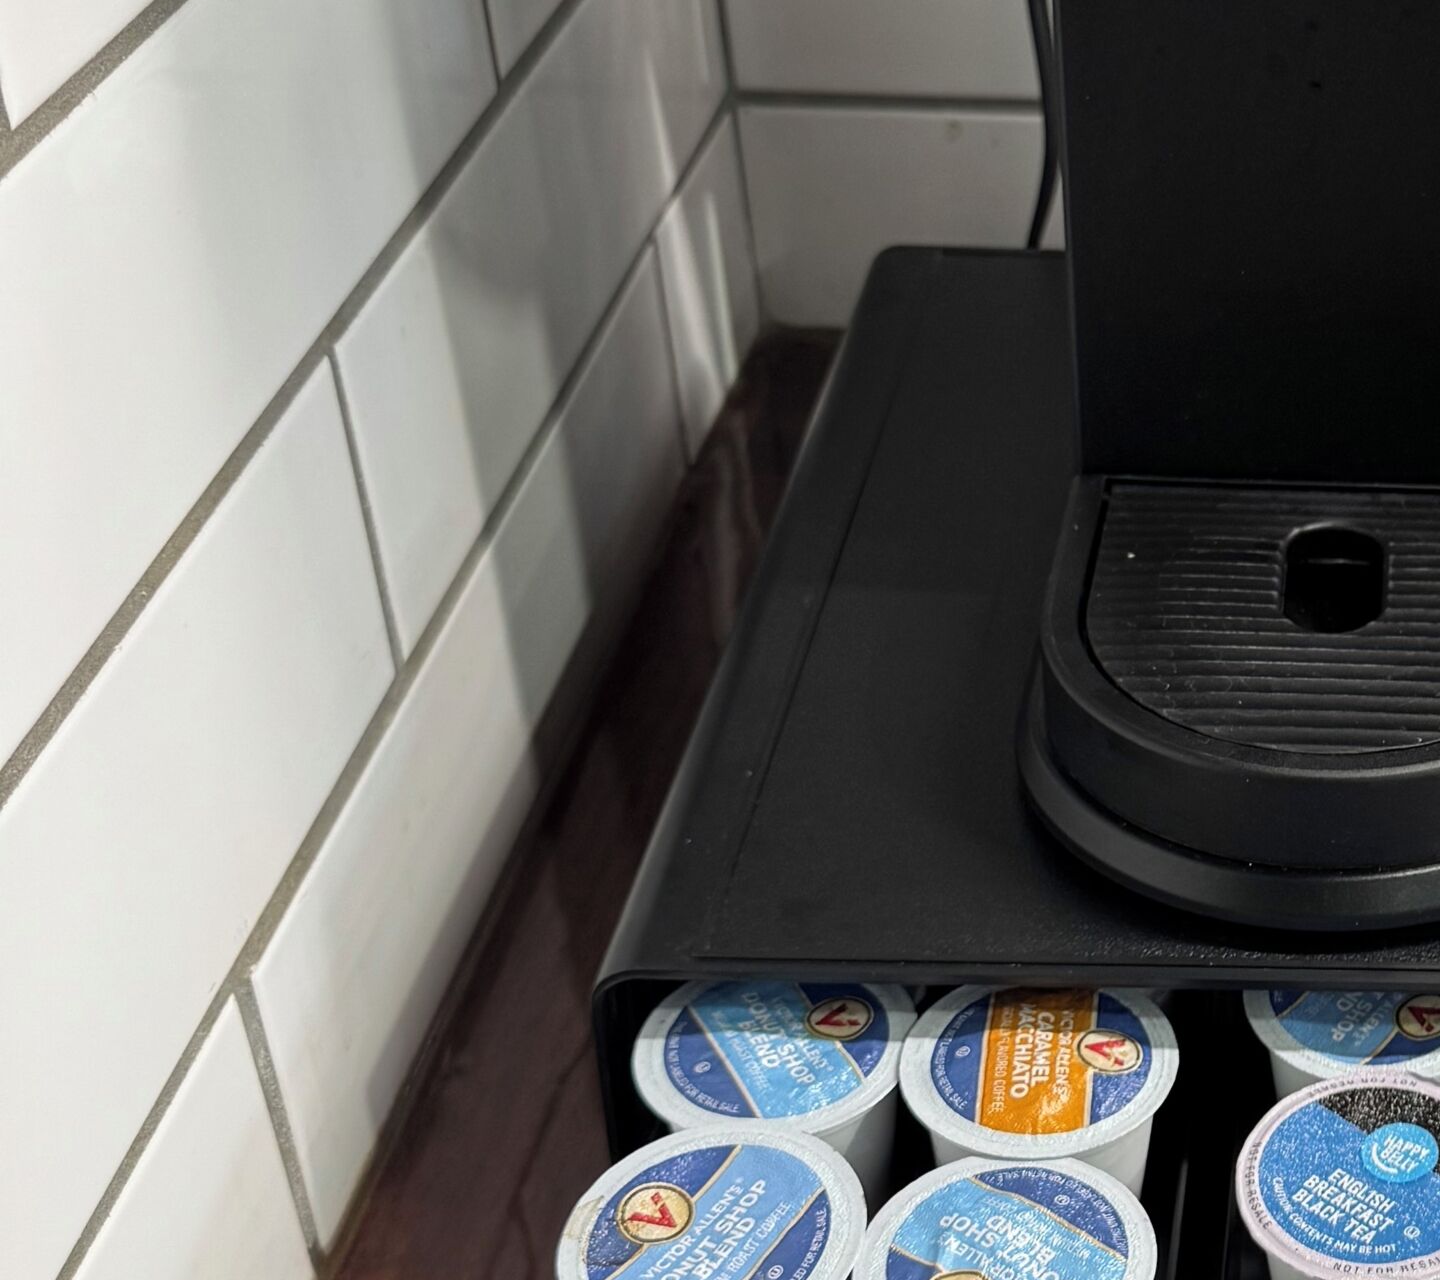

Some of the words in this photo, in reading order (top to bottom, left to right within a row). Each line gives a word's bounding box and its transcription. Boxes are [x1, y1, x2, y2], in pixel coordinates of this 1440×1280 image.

[740, 1021, 782, 1068] BLEND
[743, 992, 788, 1040] DONUT
[777, 1042, 816, 1085] SHOP
[1010, 1003, 1036, 1098] MACCHIATO
[1031, 1012, 1055, 1086] CARAMEL
[991, 1077, 1004, 1113] COFFEE
[1380, 1148, 1420, 1173] BELLY
[1383, 1133, 1432, 1160] HAPPY
[718, 1180, 767, 1236] SHOP
[1302, 1174, 1395, 1233] BREAKFAST
[1327, 1168, 1398, 1215] ENGLISH
[641, 1236, 696, 1280] VICTOR
[694, 1184, 745, 1237] ALLEN'S
[728, 1240, 758, 1273] ROAST
[758, 1201, 792, 1241] COFFEE
[816, 1209, 827, 1228] SALE
[939, 1212, 998, 1249] SHOP
[985, 1214, 1056, 1265] BLEND
[1289, 1211, 1334, 1247] CONTENTS
[1333, 1240, 1358, 1252] MAY
[1358, 1244, 1373, 1254] BE
[1374, 1244, 1396, 1254] HOT
[1291, 1188, 1345, 1226] BLACK
[1344, 1217, 1378, 1244] TEA
[802, 1251, 817, 1270] FOR
[808, 1228, 823, 1253] RETAIL
